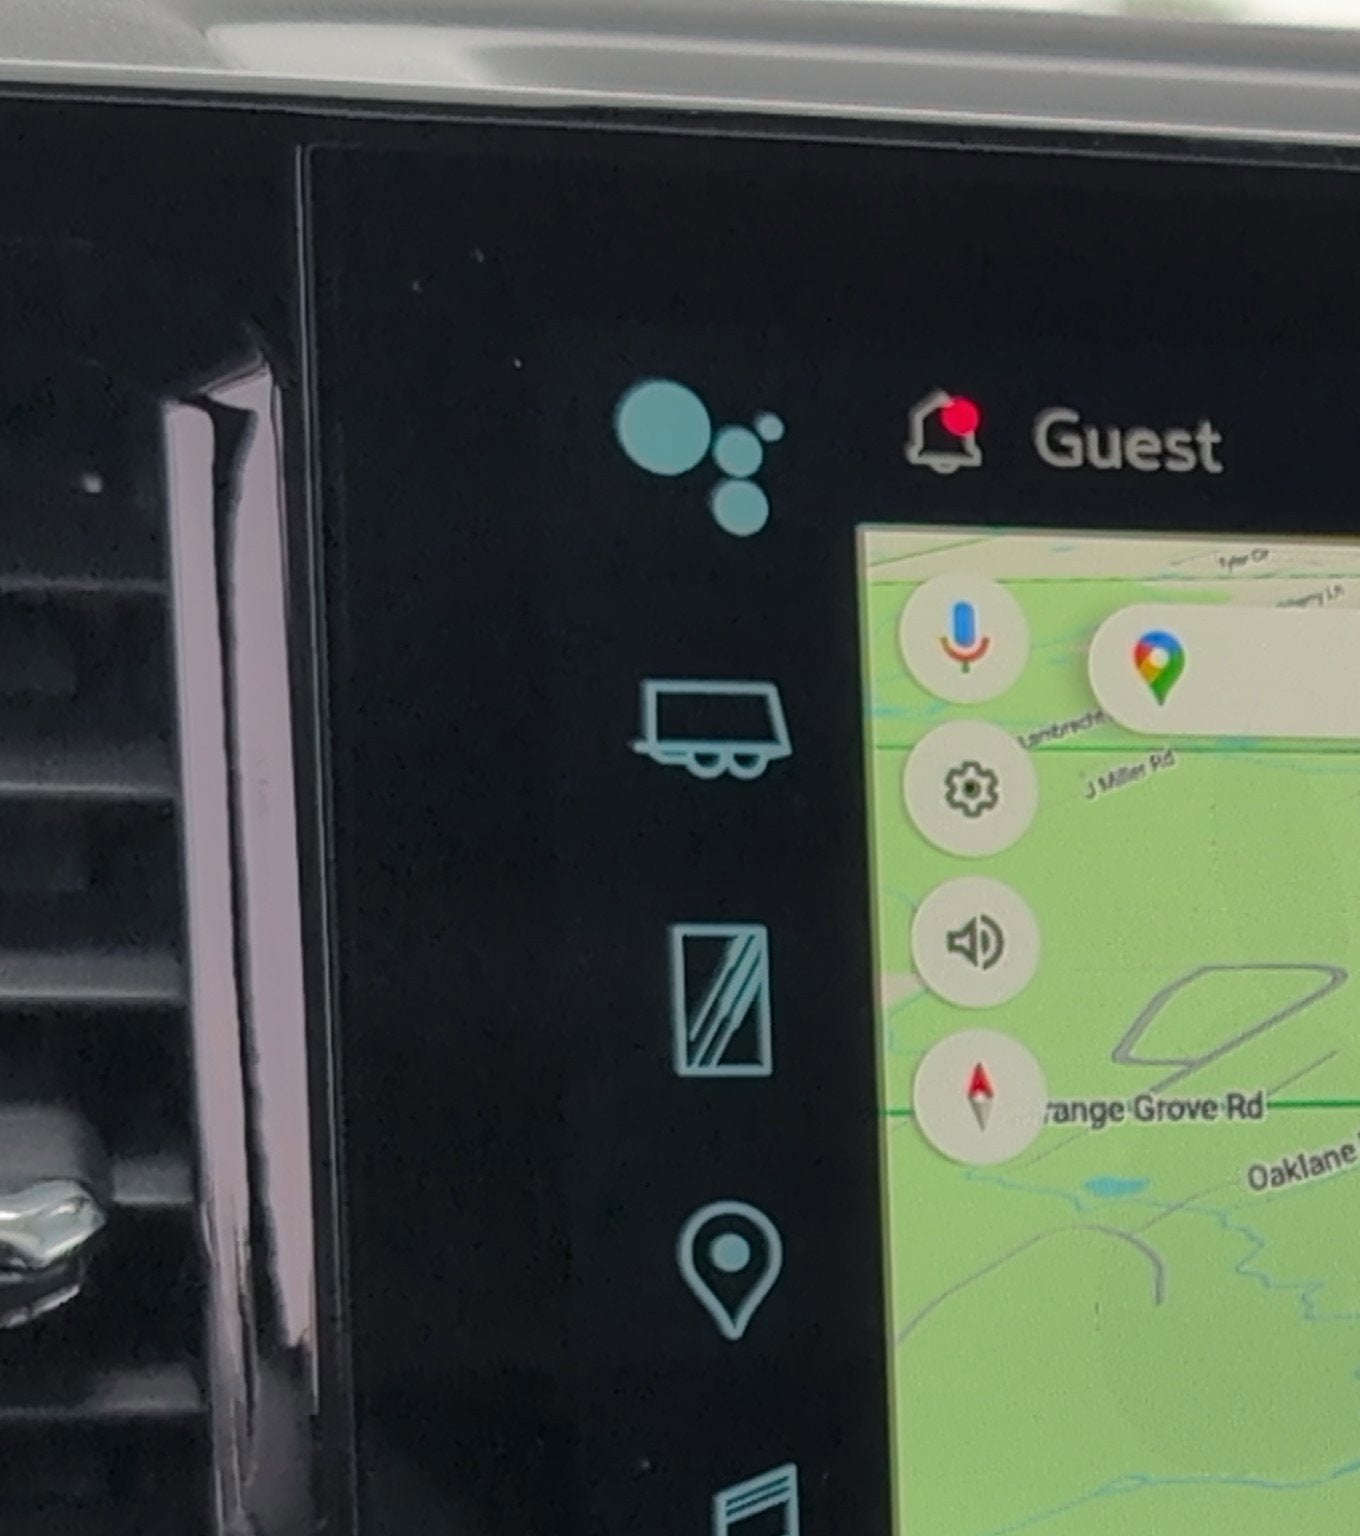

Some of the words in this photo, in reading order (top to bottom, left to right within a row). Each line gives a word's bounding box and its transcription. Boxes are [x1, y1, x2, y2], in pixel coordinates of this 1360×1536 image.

[1033, 407, 1224, 474] Guest
[1099, 762, 1146, 792] Miller
[1148, 748, 1176, 775] Rd
[1044, 1101, 1125, 1131] range
[1134, 1094, 1218, 1122] Grove
[1227, 1091, 1264, 1120] Rd
[1248, 1141, 1358, 1192] Oaklane
